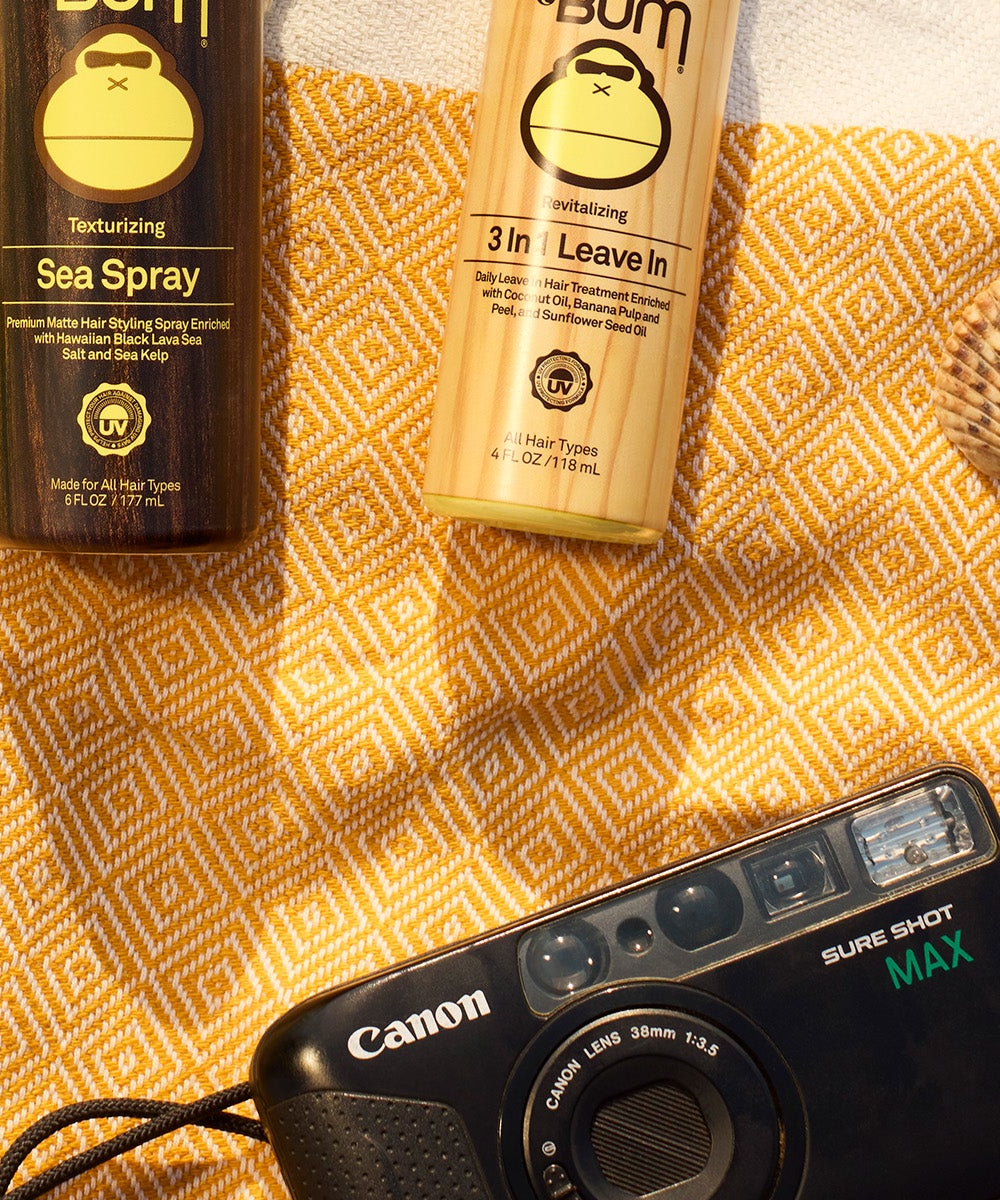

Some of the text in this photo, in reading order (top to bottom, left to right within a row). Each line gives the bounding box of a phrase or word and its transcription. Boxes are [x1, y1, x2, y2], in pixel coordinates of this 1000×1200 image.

[543, 196, 628, 224] Revitalizing
[68, 217, 165, 238] Texturizing
[488, 226, 501, 251] 3
[508, 227, 530, 254] In
[558, 233, 643, 272] Leave
[648, 249, 667, 278] In
[37, 258, 200, 297] Sea Spray
[476, 271, 497, 285] Daily
[499, 273, 529, 286] Leave
[545, 279, 569, 291] Hair
[571, 282, 629, 302] Treatment
[631, 293, 670, 311] Enriched
[483, 287, 659, 324] with Coconut Oil, Banana Pulp and
[7, 316, 230, 332] Premium Matte Hair Styling Spray Enriched
[492, 304, 517, 318] Peel,
[542, 310, 603, 328] Sunflower
[605, 320, 632, 334] Seed
[634, 325, 647, 337] Oil
[34, 332, 202, 345] with Hawaiian Black Lava Sea
[63, 349, 168, 363] Salt and Sea Kelp
[547, 380, 573, 395] UV
[99, 420, 128, 436] UV
[504, 432, 598, 456] All Hair Types
[491, 448, 499, 459] 4
[503, 449, 518, 462] FL
[522, 452, 542, 466] OZ
[580, 463, 600, 475] mL
[51, 478, 180, 493] Made for All Hair Types
[65, 494, 71, 505] 6
[74, 494, 88, 506] FL
[90, 494, 107, 506] OZ
[122, 495, 142, 506] 177
[146, 495, 164, 506] mL
[821, 904, 953, 966] SURE SHOT
[885, 930, 974, 989] MAX
[348, 990, 491, 1060] Canon
[546, 1025, 720, 1110] CANON LENS 38mm 1:3.5
